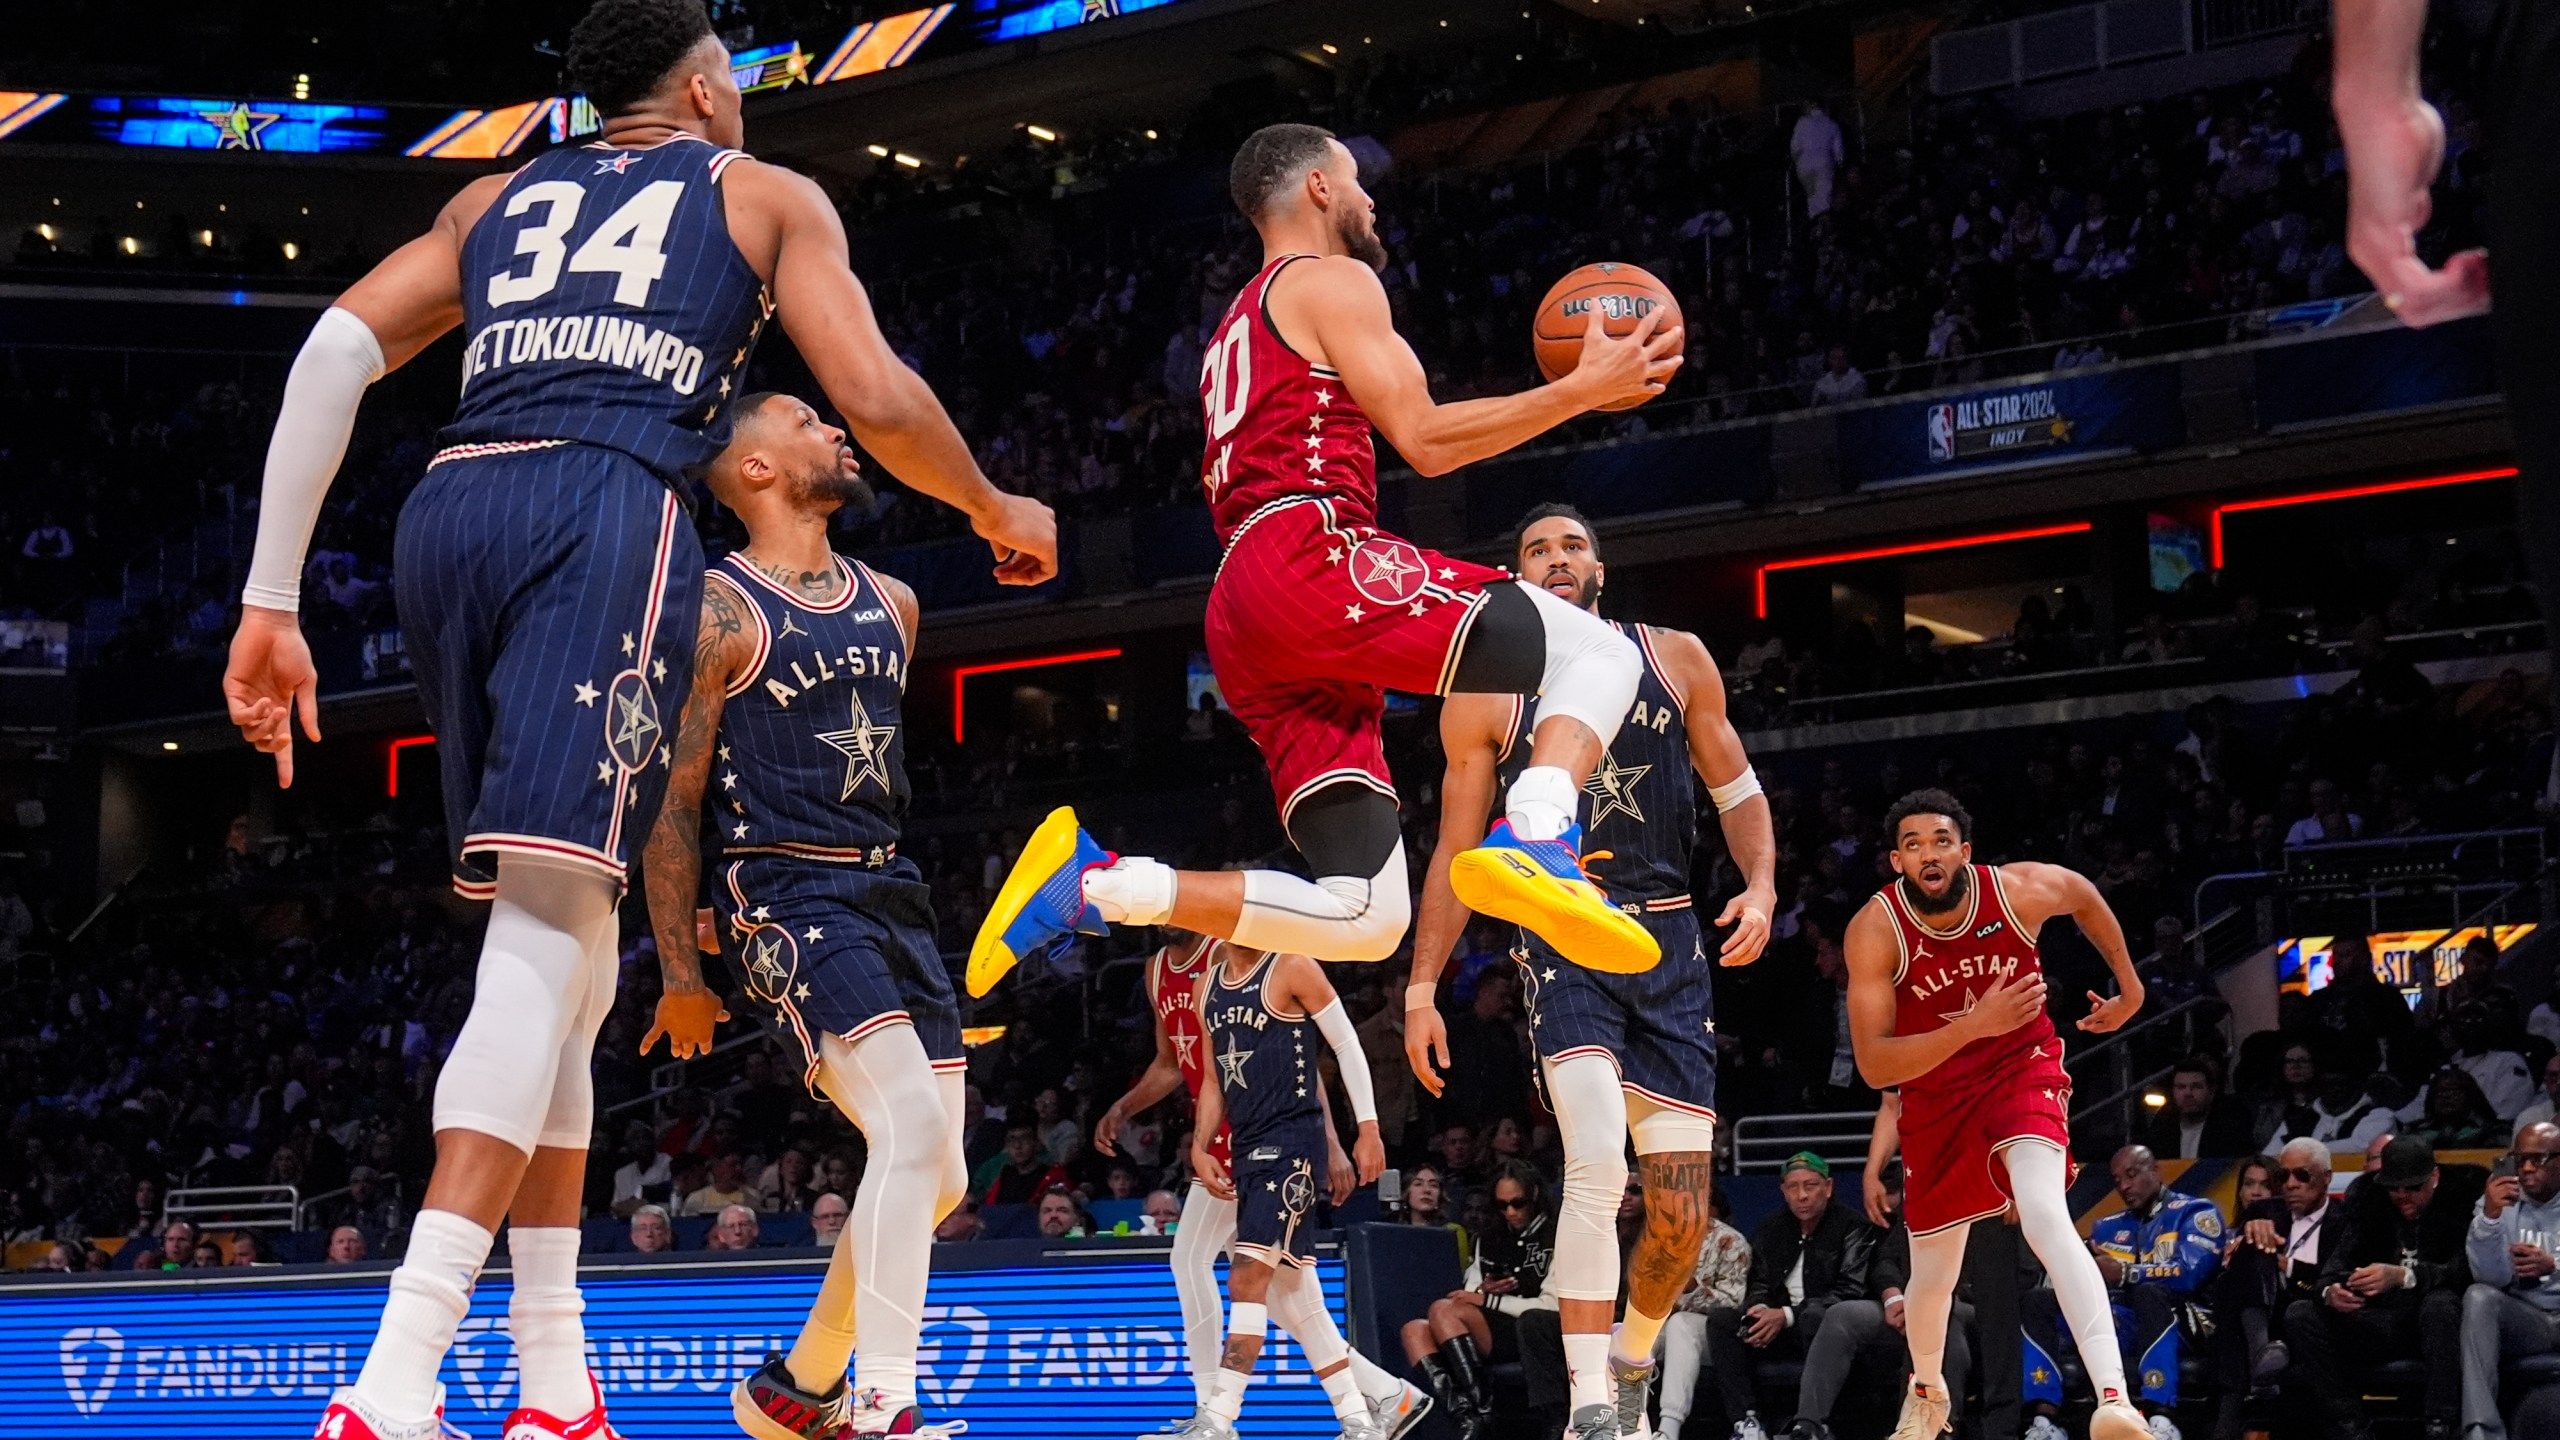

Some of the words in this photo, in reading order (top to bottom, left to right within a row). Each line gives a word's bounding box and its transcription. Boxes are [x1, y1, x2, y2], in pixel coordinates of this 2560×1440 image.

[487, 180, 685, 309] 34
[2021, 388, 2055, 420] 2024
[1990, 428, 2026, 447] INDY
[1910, 954, 2018, 1001] ALL-STAR
[1206, 1005, 1269, 1033] LL-STAR
[2145, 1265, 2181, 1278] 2024
